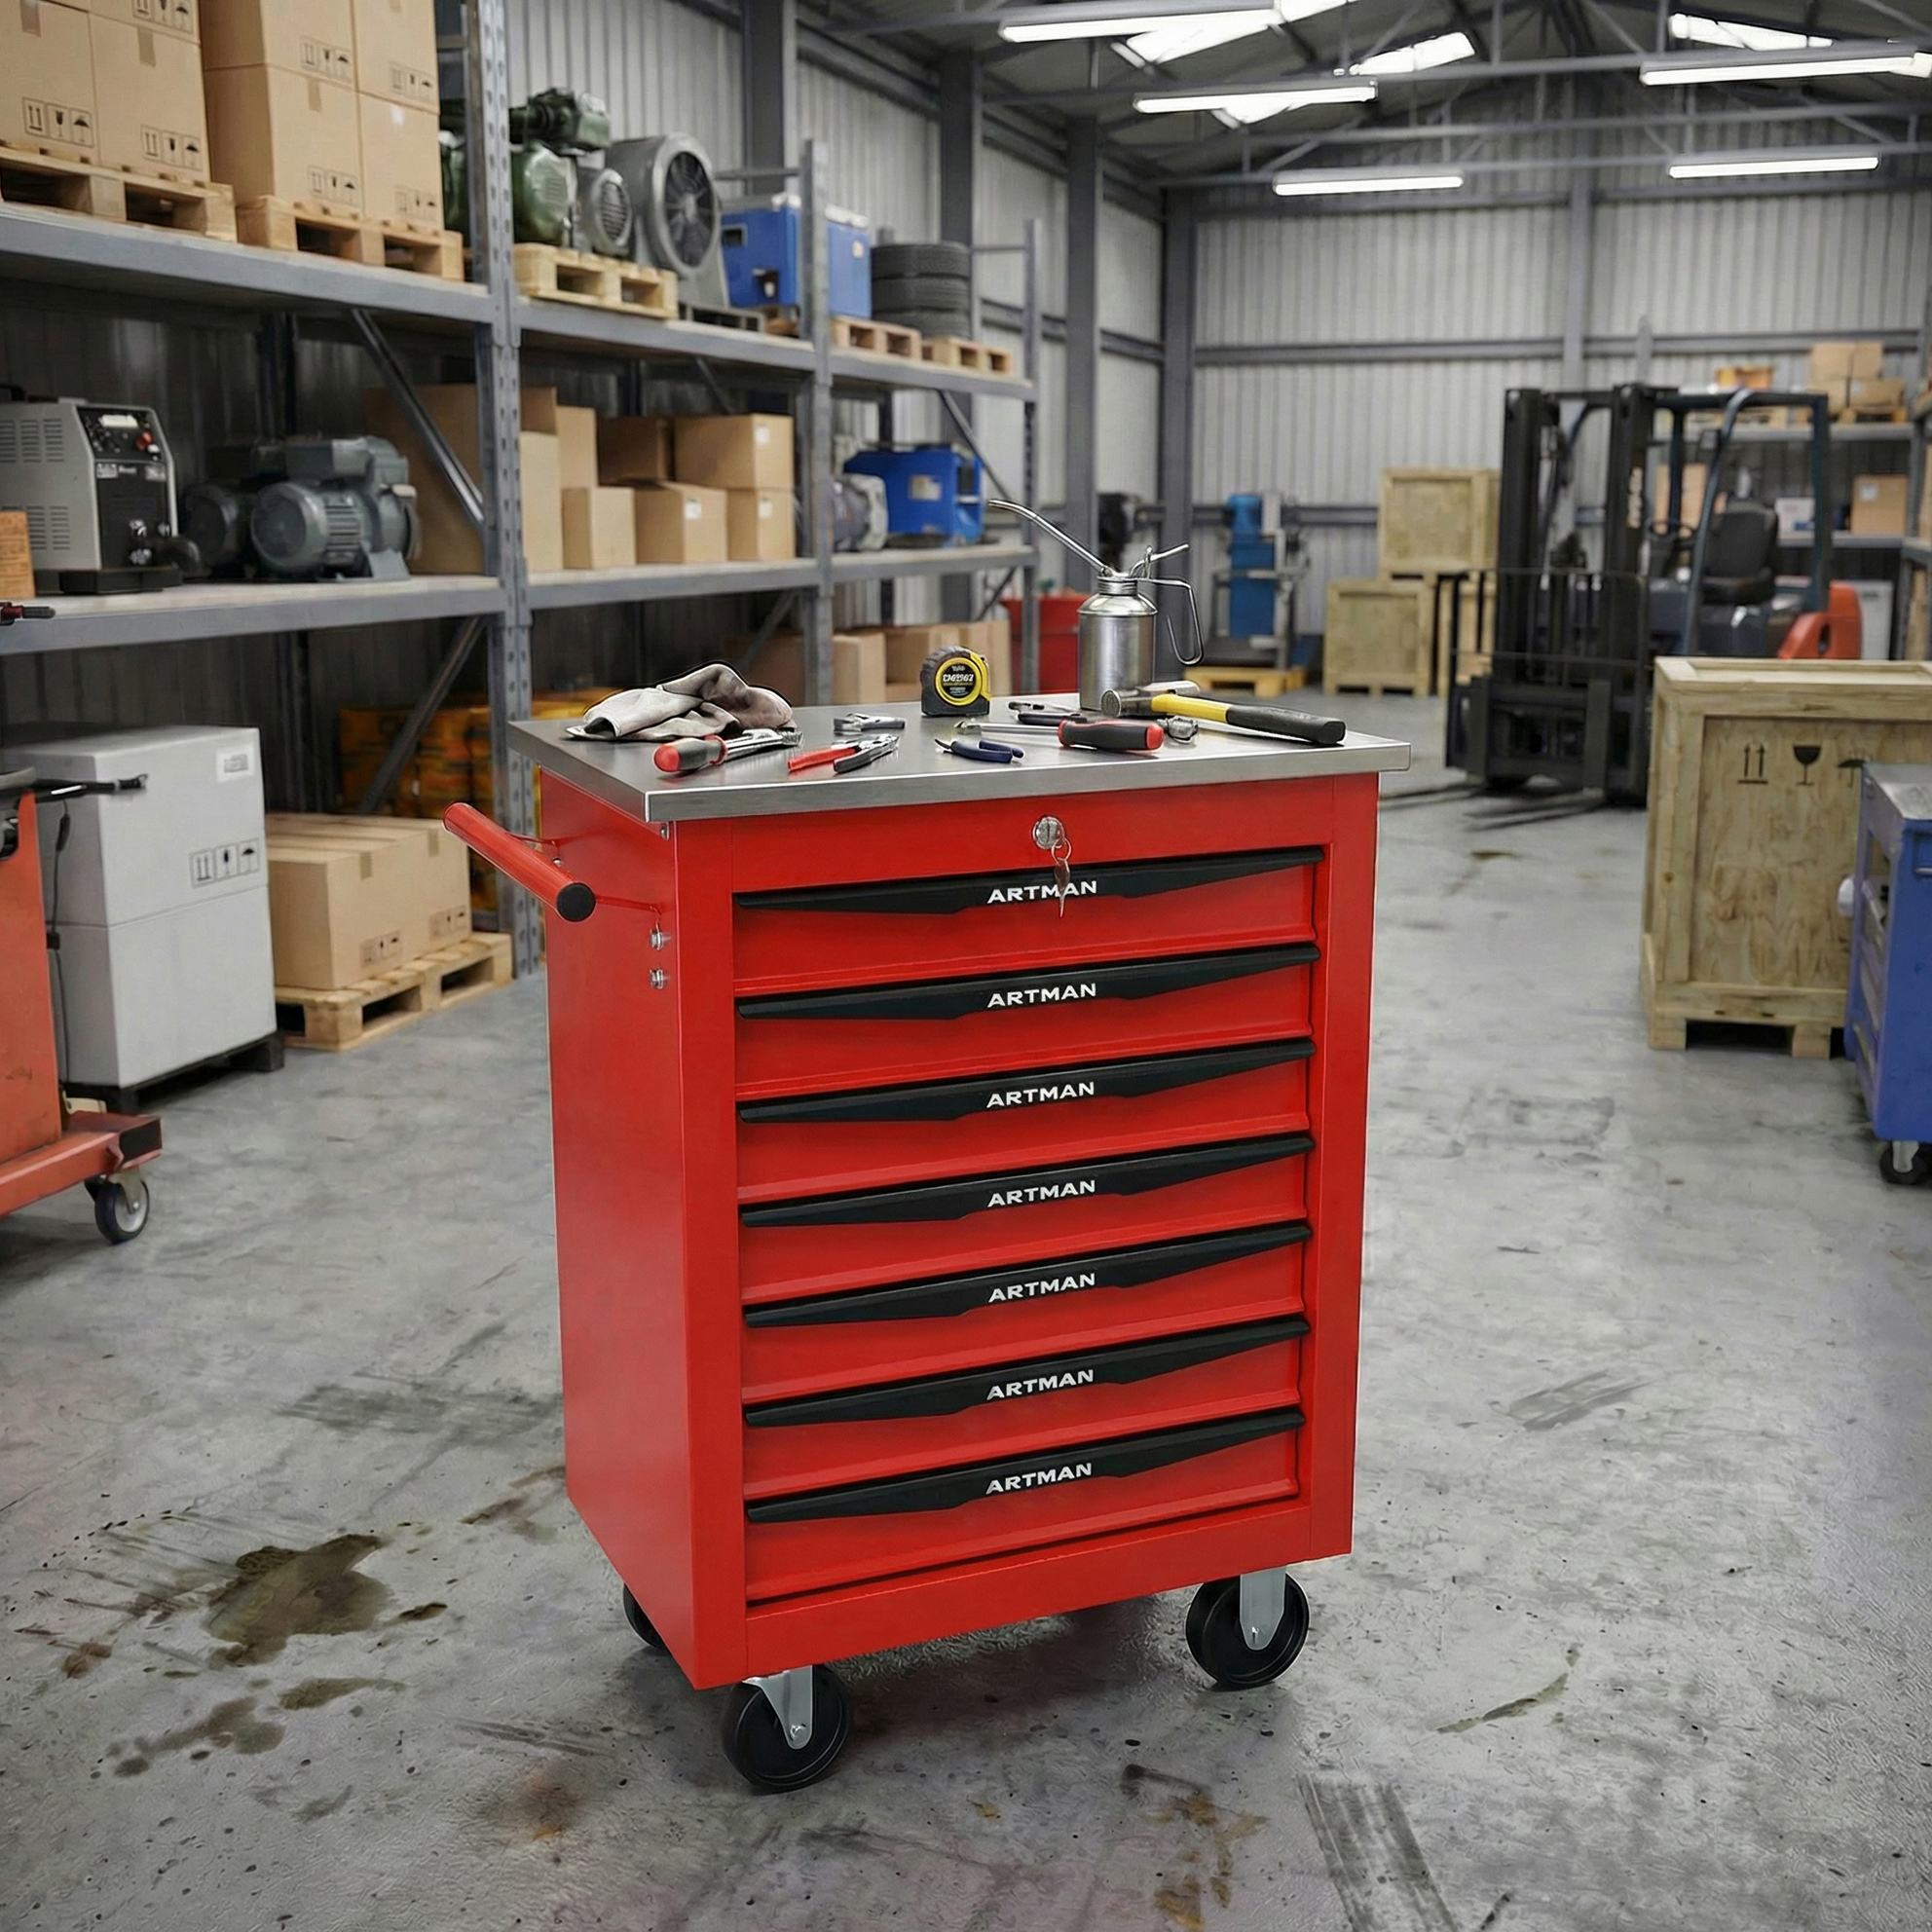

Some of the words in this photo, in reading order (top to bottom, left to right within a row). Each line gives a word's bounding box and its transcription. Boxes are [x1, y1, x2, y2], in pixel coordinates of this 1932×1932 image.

[986, 880, 1096, 905] ARTMAN
[986, 983, 1096, 1009] ARTMAN
[986, 1081, 1095, 1109] ARTMAN
[986, 1179, 1096, 1208] ARTMAN
[987, 1273, 1096, 1303] ARTMAN
[986, 1368, 1094, 1400] ARTMAN
[985, 1463, 1092, 1495] ARTMAN
